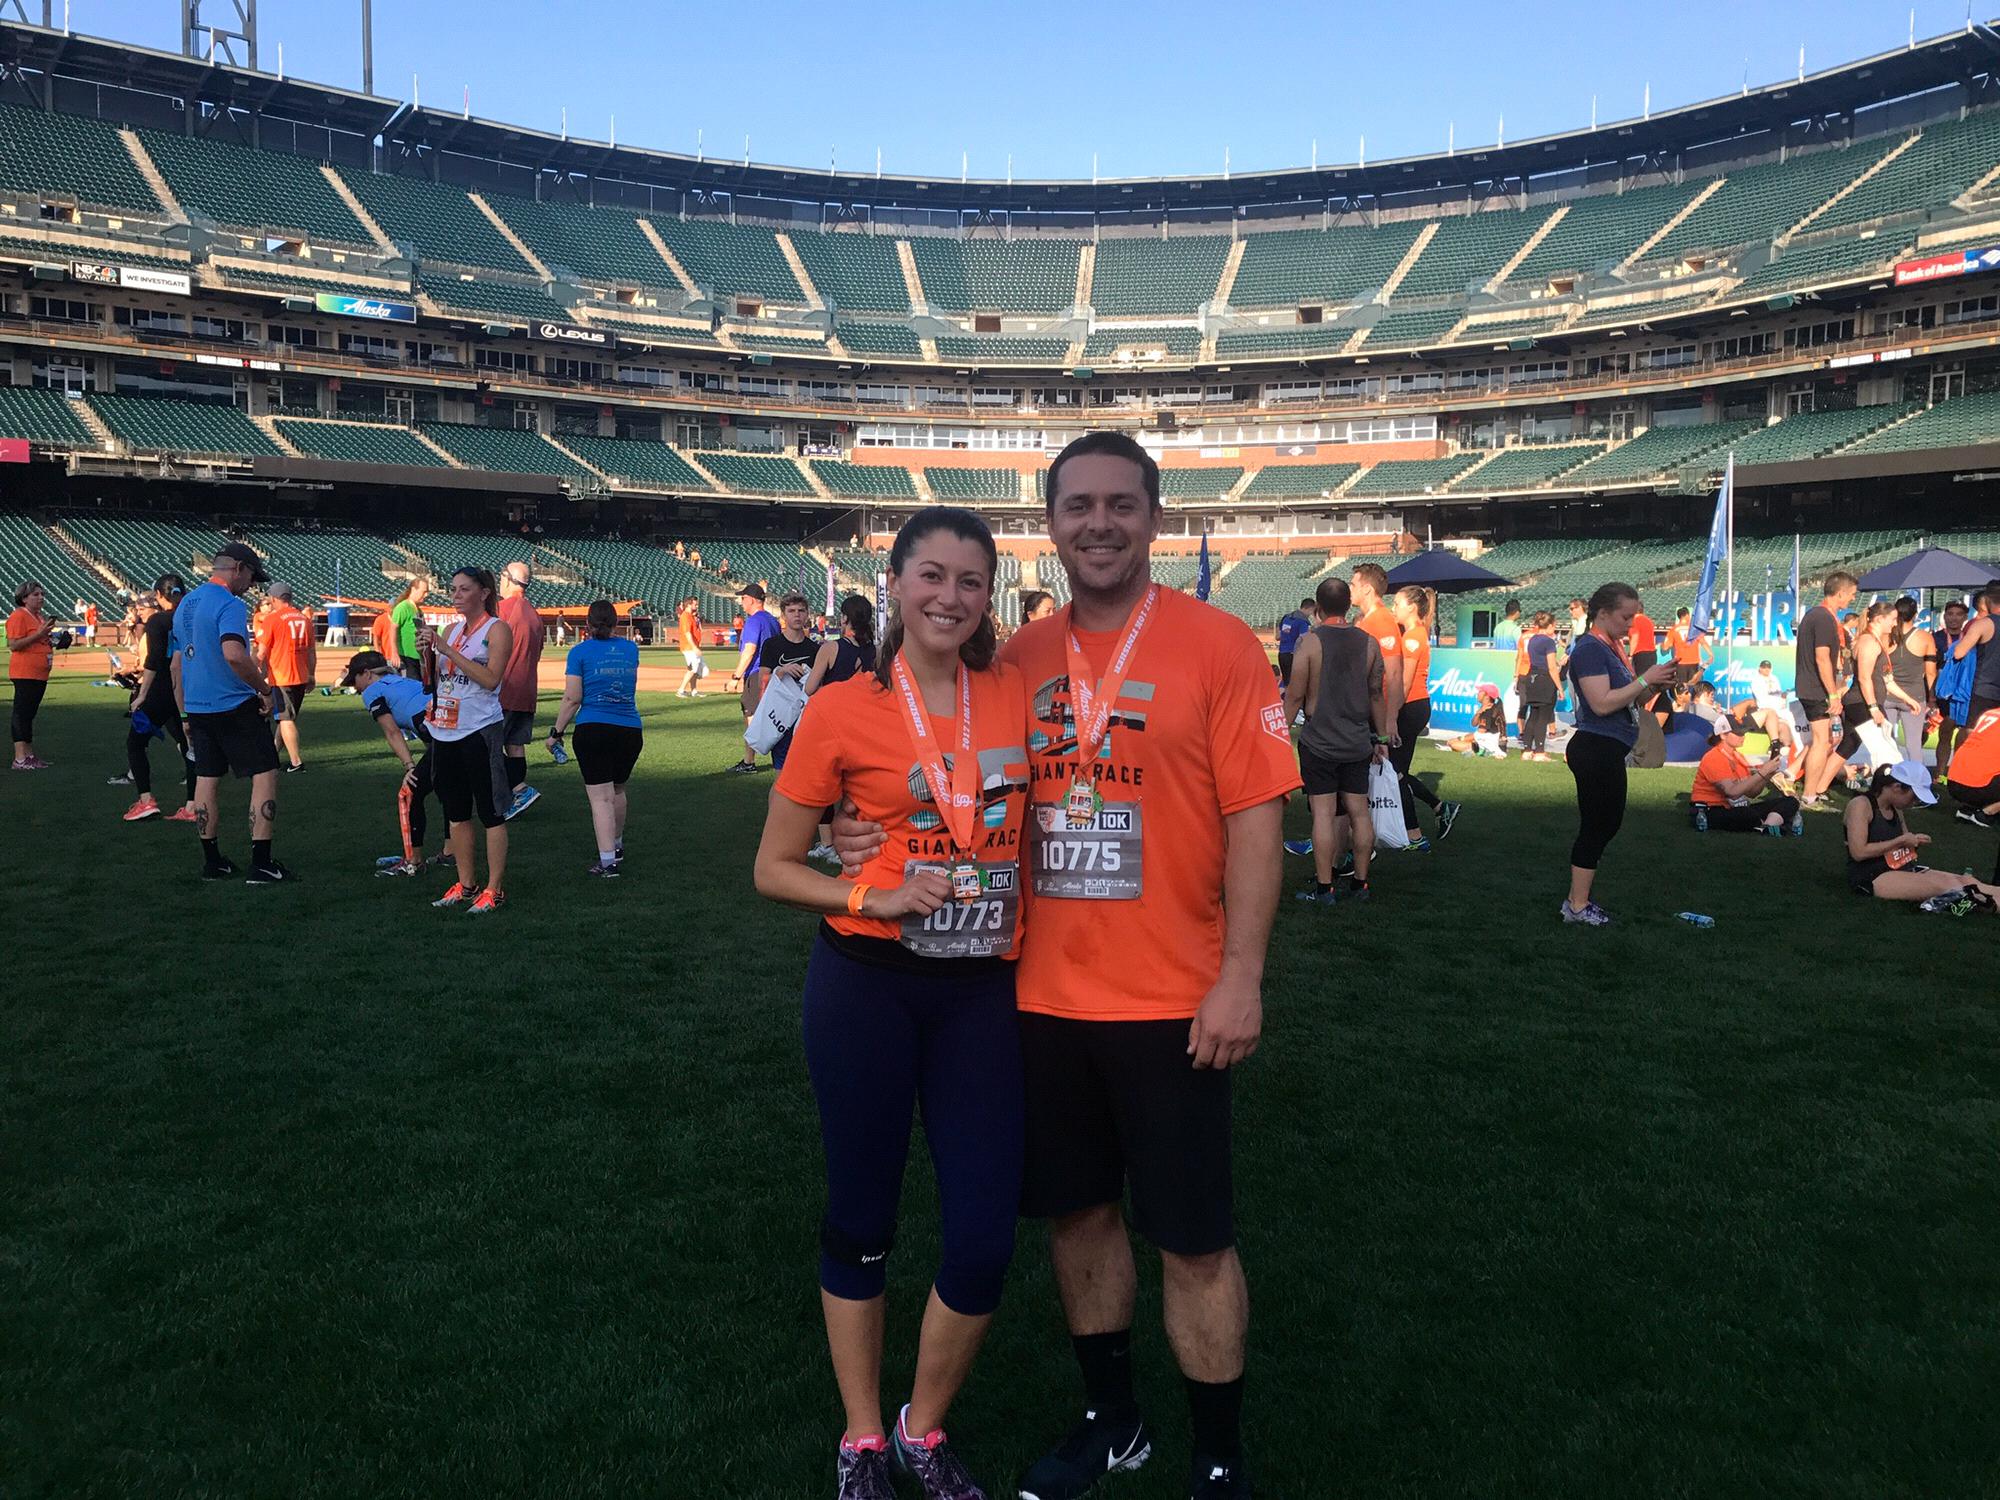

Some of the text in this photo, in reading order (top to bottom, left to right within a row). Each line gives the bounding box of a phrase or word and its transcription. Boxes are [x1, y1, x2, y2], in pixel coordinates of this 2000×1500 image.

[75, 263, 101, 274] NBC
[76, 272, 117, 283] BAY AREA
[1899, 260, 1979, 280] Bank of America
[140, 276, 186, 288] INVESTIGATE
[343, 299, 391, 318] Alaska
[558, 328, 605, 343] LEXUS
[287, 620, 305, 639] 17
[905, 692, 927, 737] FINISHER
[1090, 700, 1109, 745] Alaska
[930, 761, 952, 805] Alaska
[1093, 762, 1144, 786] RACE
[1102, 813, 1128, 829] 10K
[907, 838, 972, 856] GIAN
[1041, 840, 1121, 872] 10775
[991, 872, 1011, 888] 10K
[923, 899, 1005, 931] 10773
